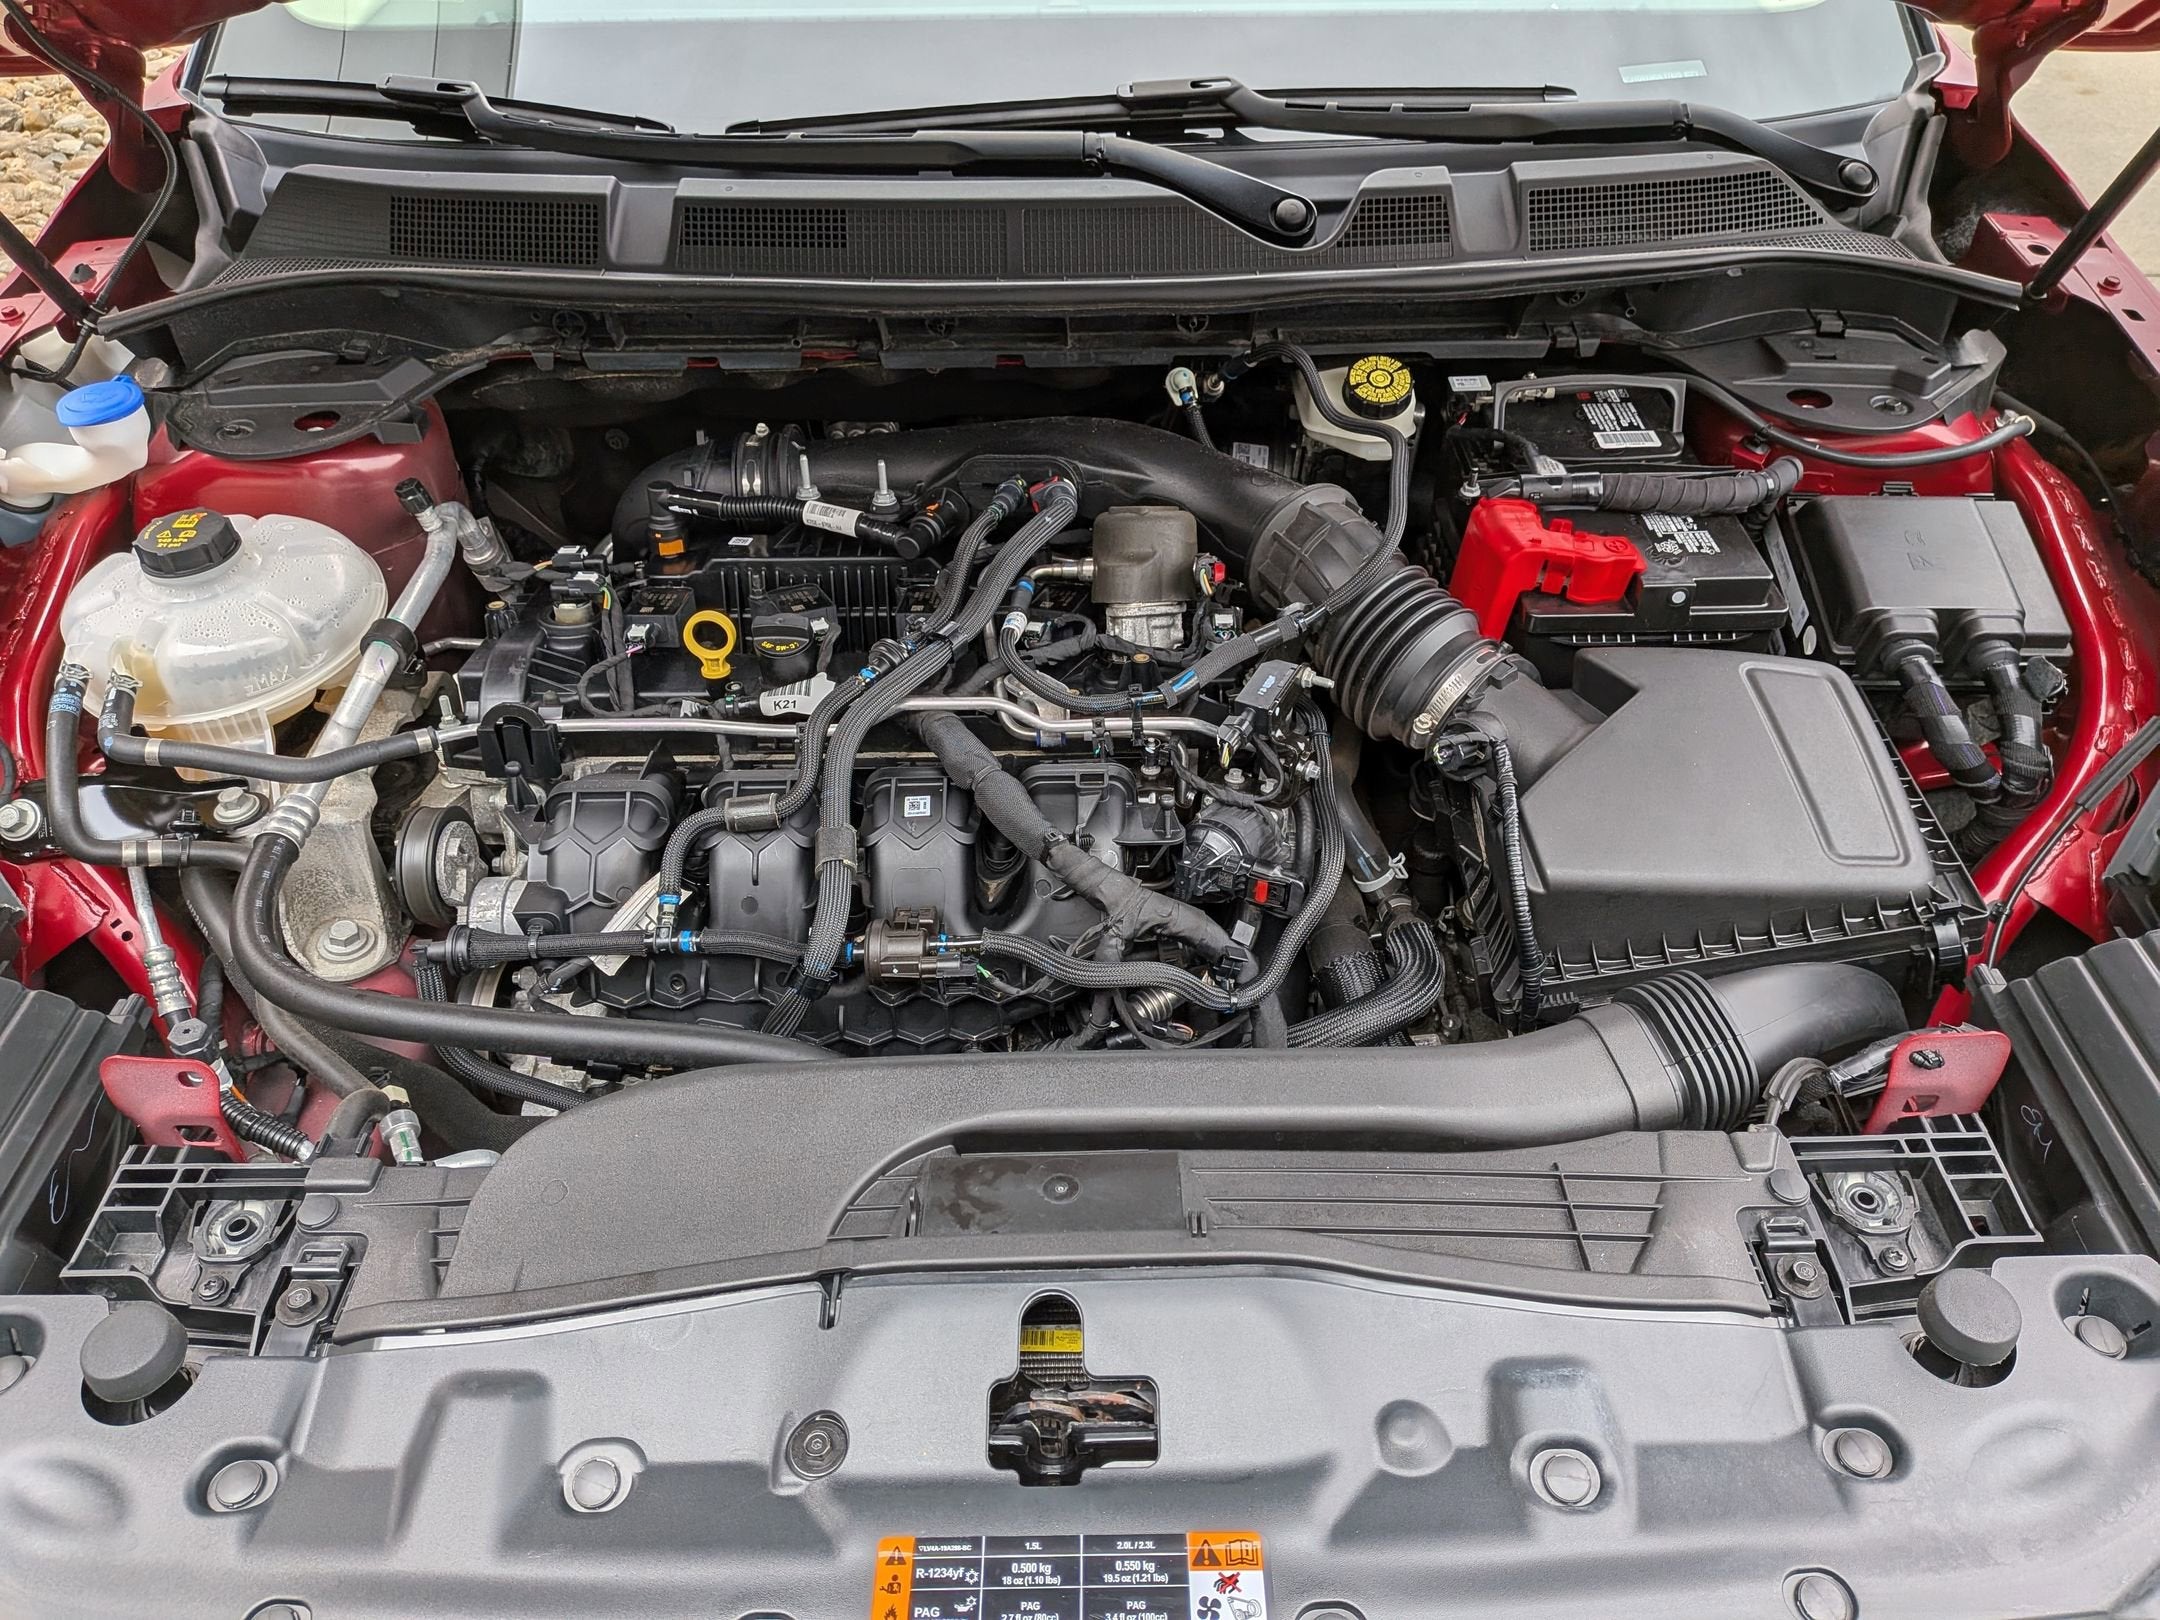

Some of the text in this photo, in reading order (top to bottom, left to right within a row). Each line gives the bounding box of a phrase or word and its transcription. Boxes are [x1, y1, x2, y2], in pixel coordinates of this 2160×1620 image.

[254, 664, 295, 691] MAX
[773, 699, 797, 711] K21
[1024, 1542, 1043, 1550] 1.5L
[1116, 1541, 1134, 1550] 2.0L
[1138, 1541, 1156, 1549] 2.3L
[1011, 1562, 1052, 1575] 0.500 kg
[1115, 1560, 1155, 1573] 0.550 kg
[915, 1567, 965, 1580] R-1234yf
[1103, 1573, 1168, 1584] 19.5 oz (1.21 lbs)
[1001, 1575, 1061, 1586] 18 oz (1.10 lbs)
[1020, 1601, 1041, 1611] PAG
[1126, 1600, 1146, 1610] PAG
[914, 1606, 940, 1618] PAG
